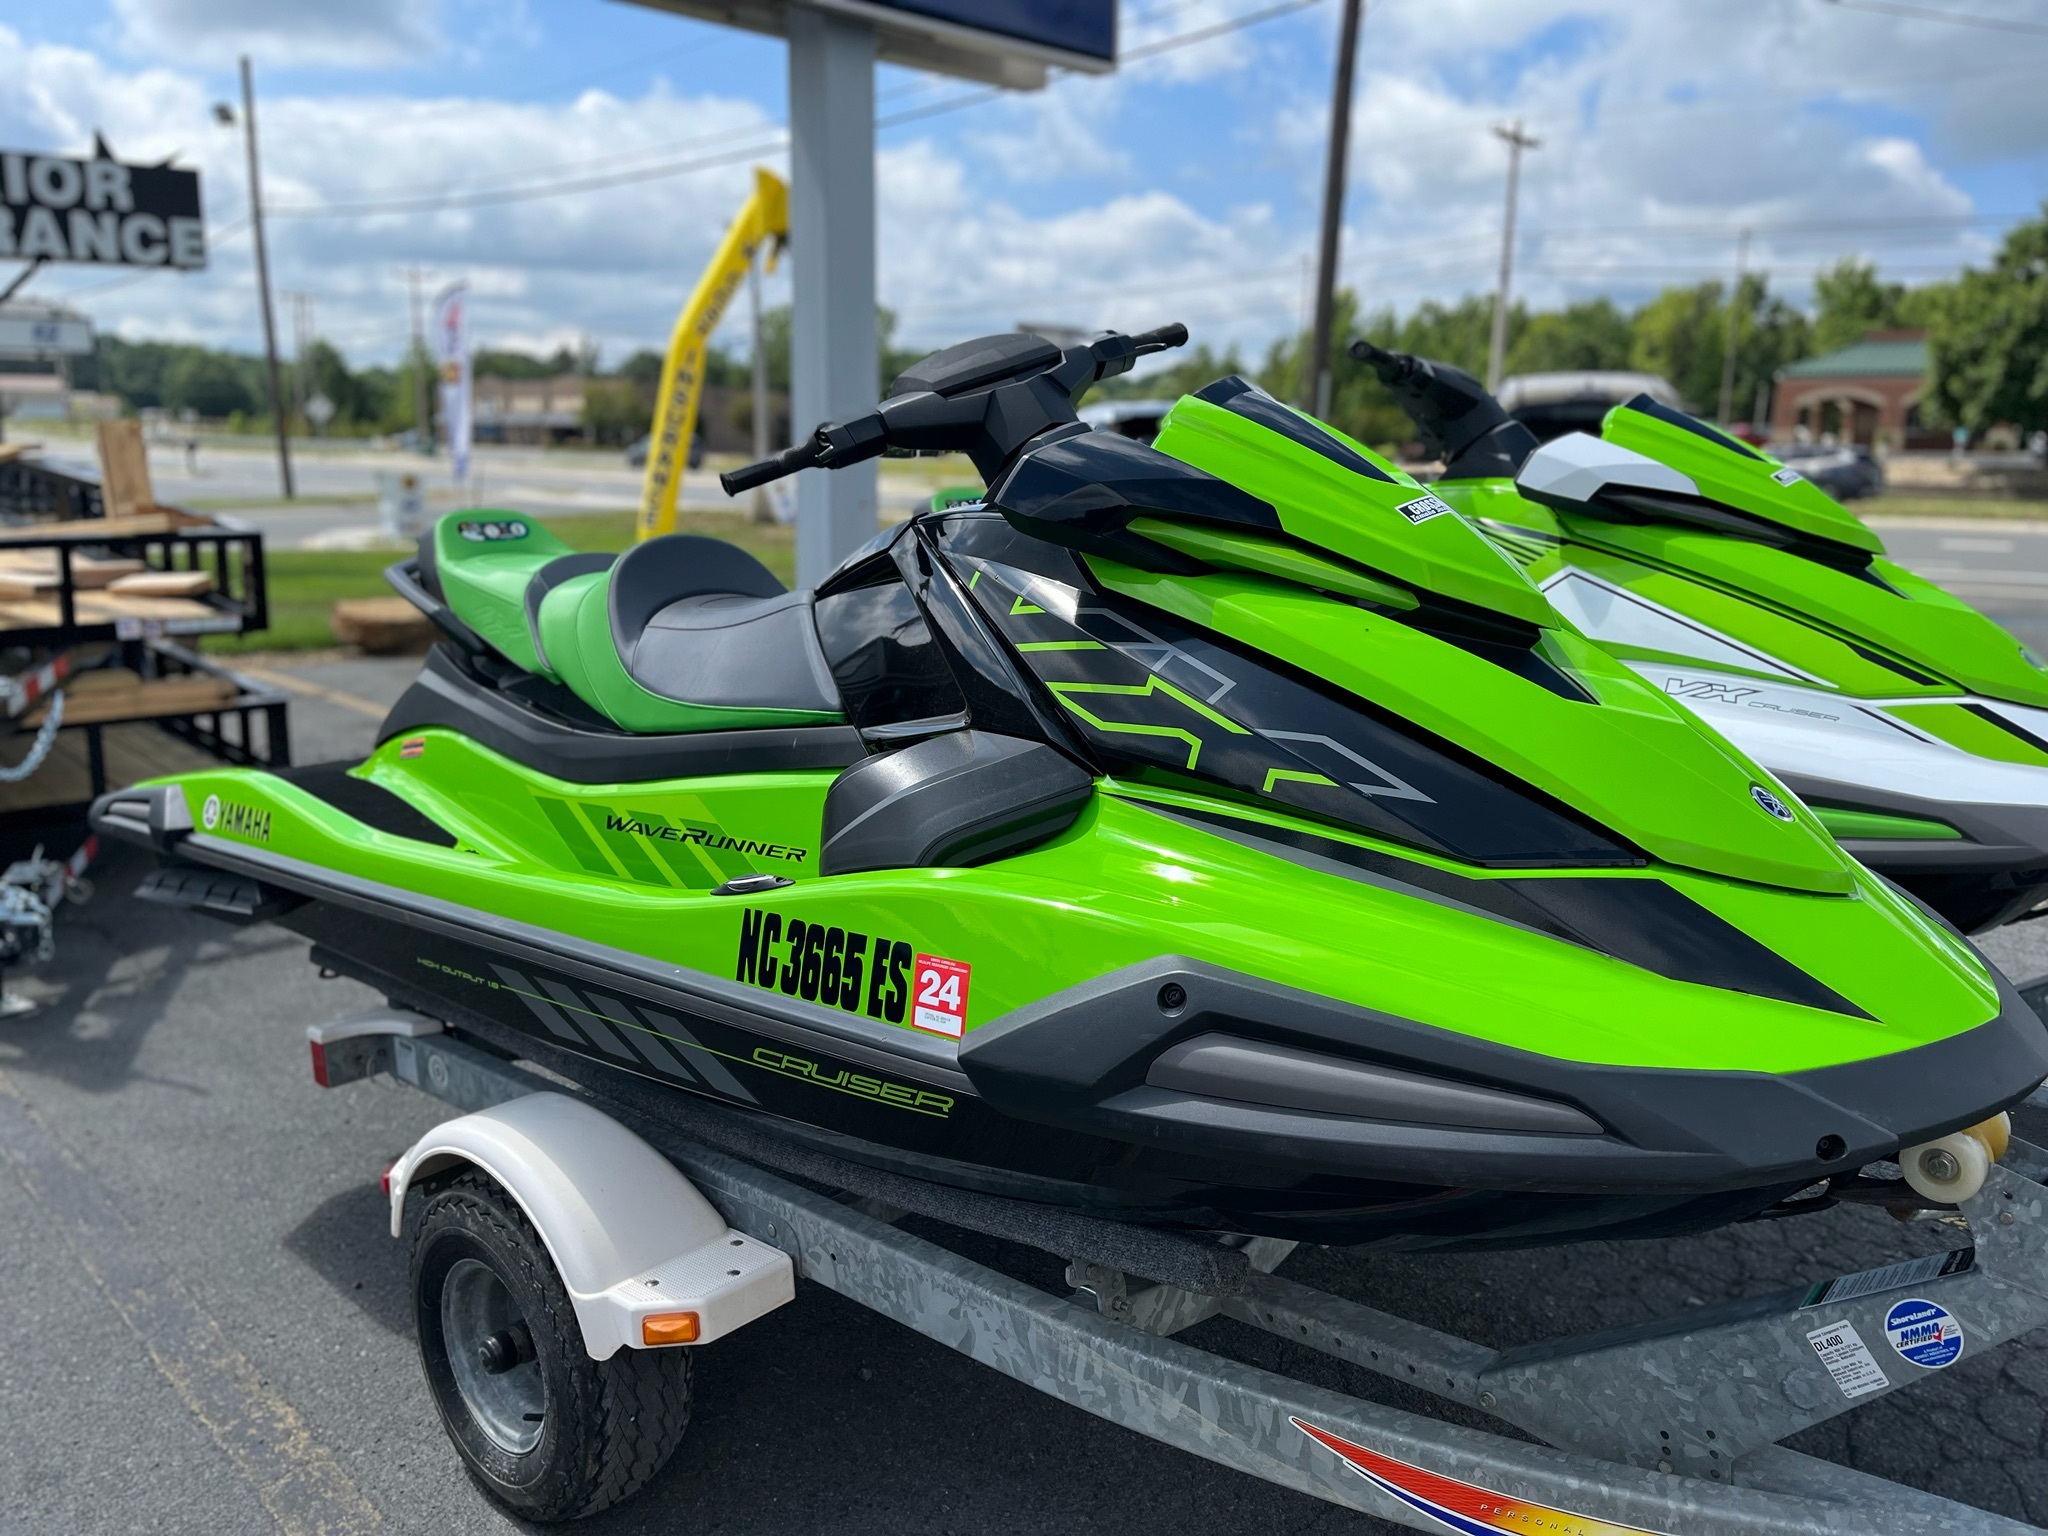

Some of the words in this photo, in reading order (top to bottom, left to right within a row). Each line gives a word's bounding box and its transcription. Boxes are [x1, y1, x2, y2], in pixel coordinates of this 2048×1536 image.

[2, 152, 135, 214] IOR
[1665, 678, 1763, 703] VX
[1748, 701, 1840, 722] CRUISER
[220, 801, 272, 842] YAMAHA
[442, 965, 485, 984] OUTPUT
[736, 908, 782, 989] NC
[780, 918, 868, 1013] 3665
[867, 937, 913, 1024] ES
[918, 969, 961, 1011] 24
[752, 1047, 954, 1112] CRUISER
[1813, 1334, 1844, 1352] DL400
[1896, 1334, 1933, 1348] CERTIFIED
[1480, 1503, 1584, 1536] PERSONAL
